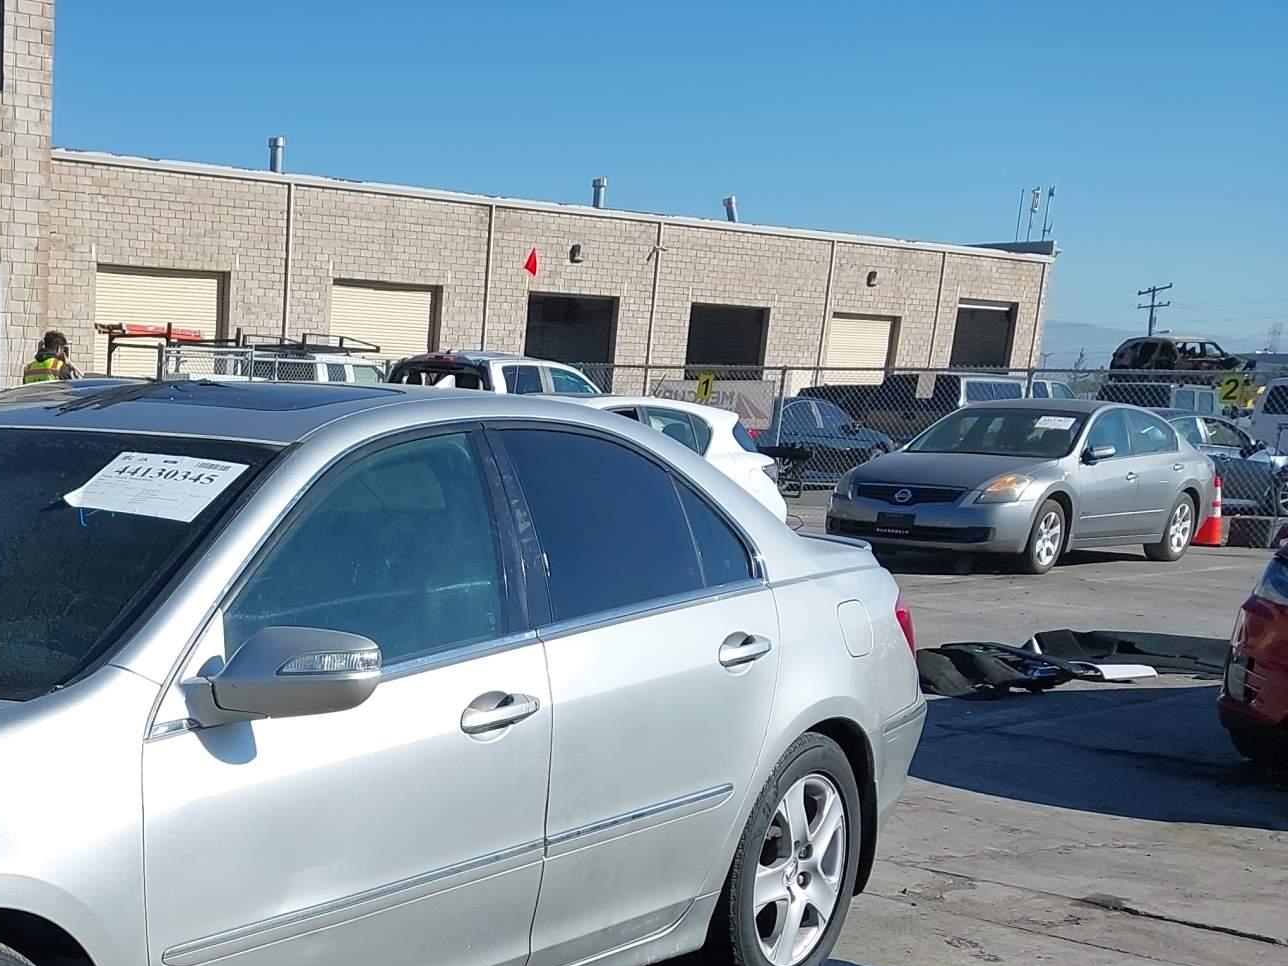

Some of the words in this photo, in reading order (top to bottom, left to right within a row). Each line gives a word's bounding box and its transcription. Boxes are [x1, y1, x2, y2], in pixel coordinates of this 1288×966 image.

[701, 377, 711, 397] 1
[1222, 378, 1240, 400] 2
[114, 464, 219, 485] 44130345
